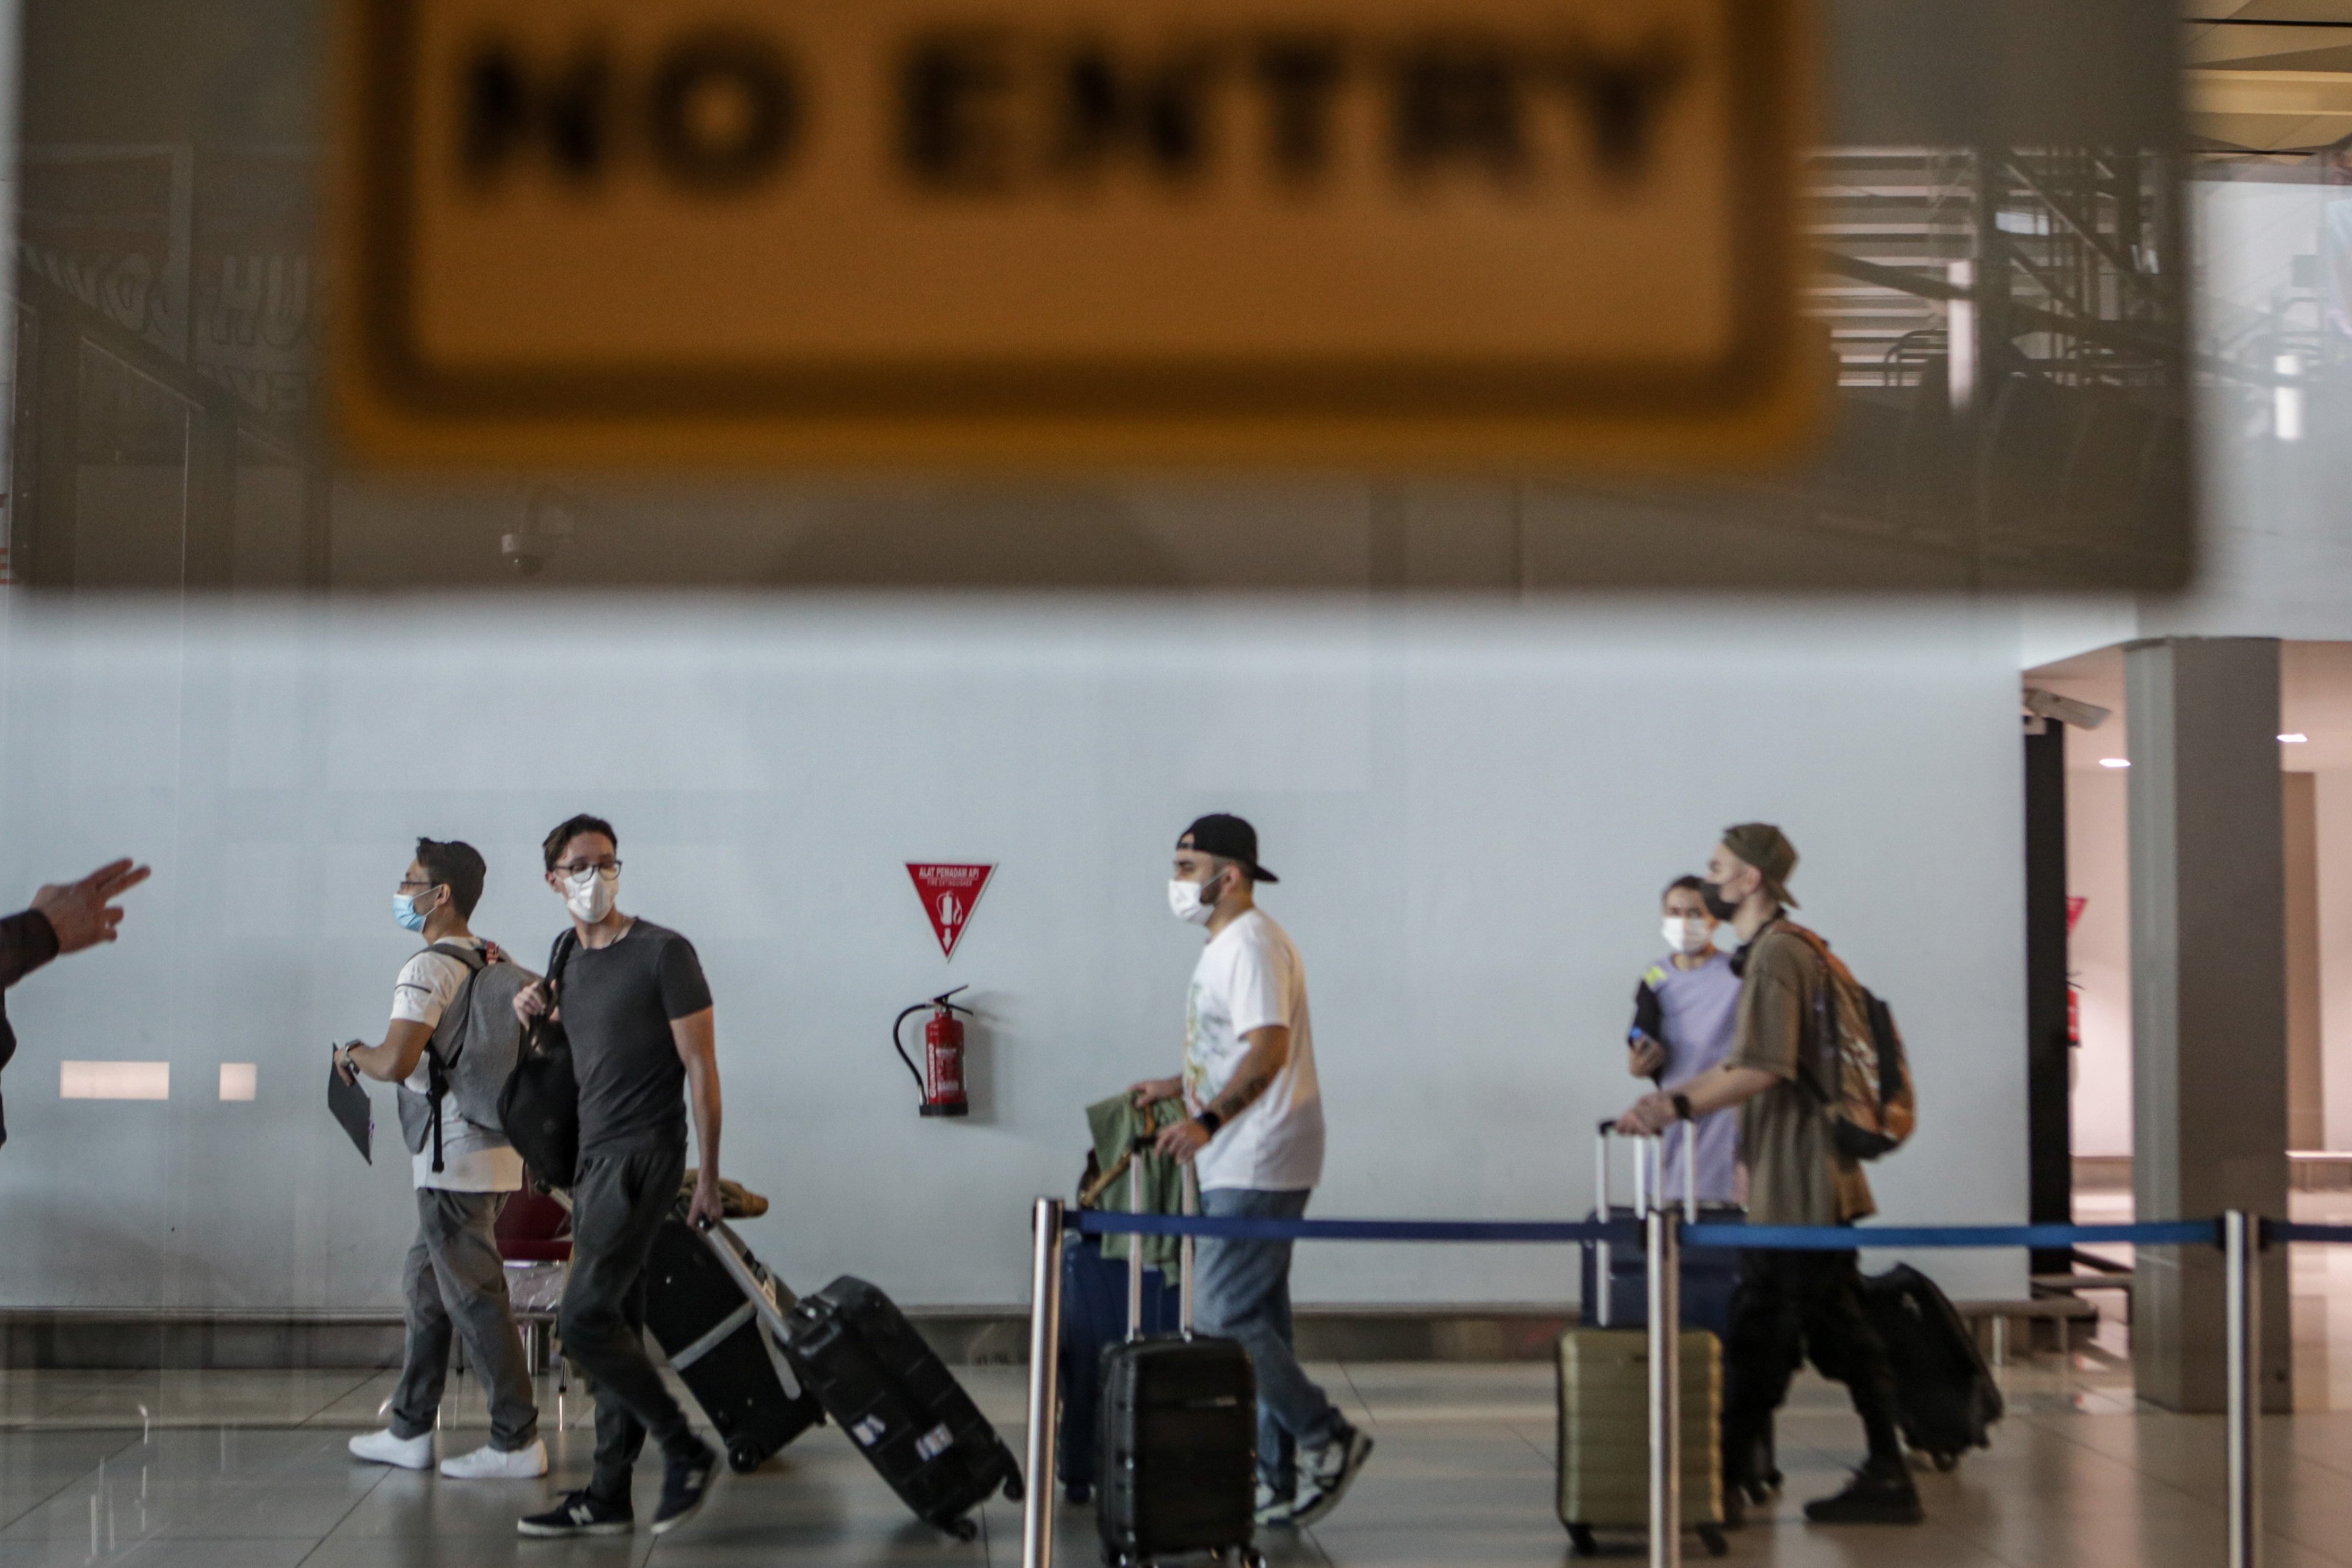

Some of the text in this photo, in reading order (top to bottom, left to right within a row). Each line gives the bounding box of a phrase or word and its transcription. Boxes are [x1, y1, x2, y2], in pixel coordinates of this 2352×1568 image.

[462, 26, 1685, 197] NO ENTRY
[919, 866, 979, 880] ALAT PEMADAM API
[568, 1503, 594, 1525] N
